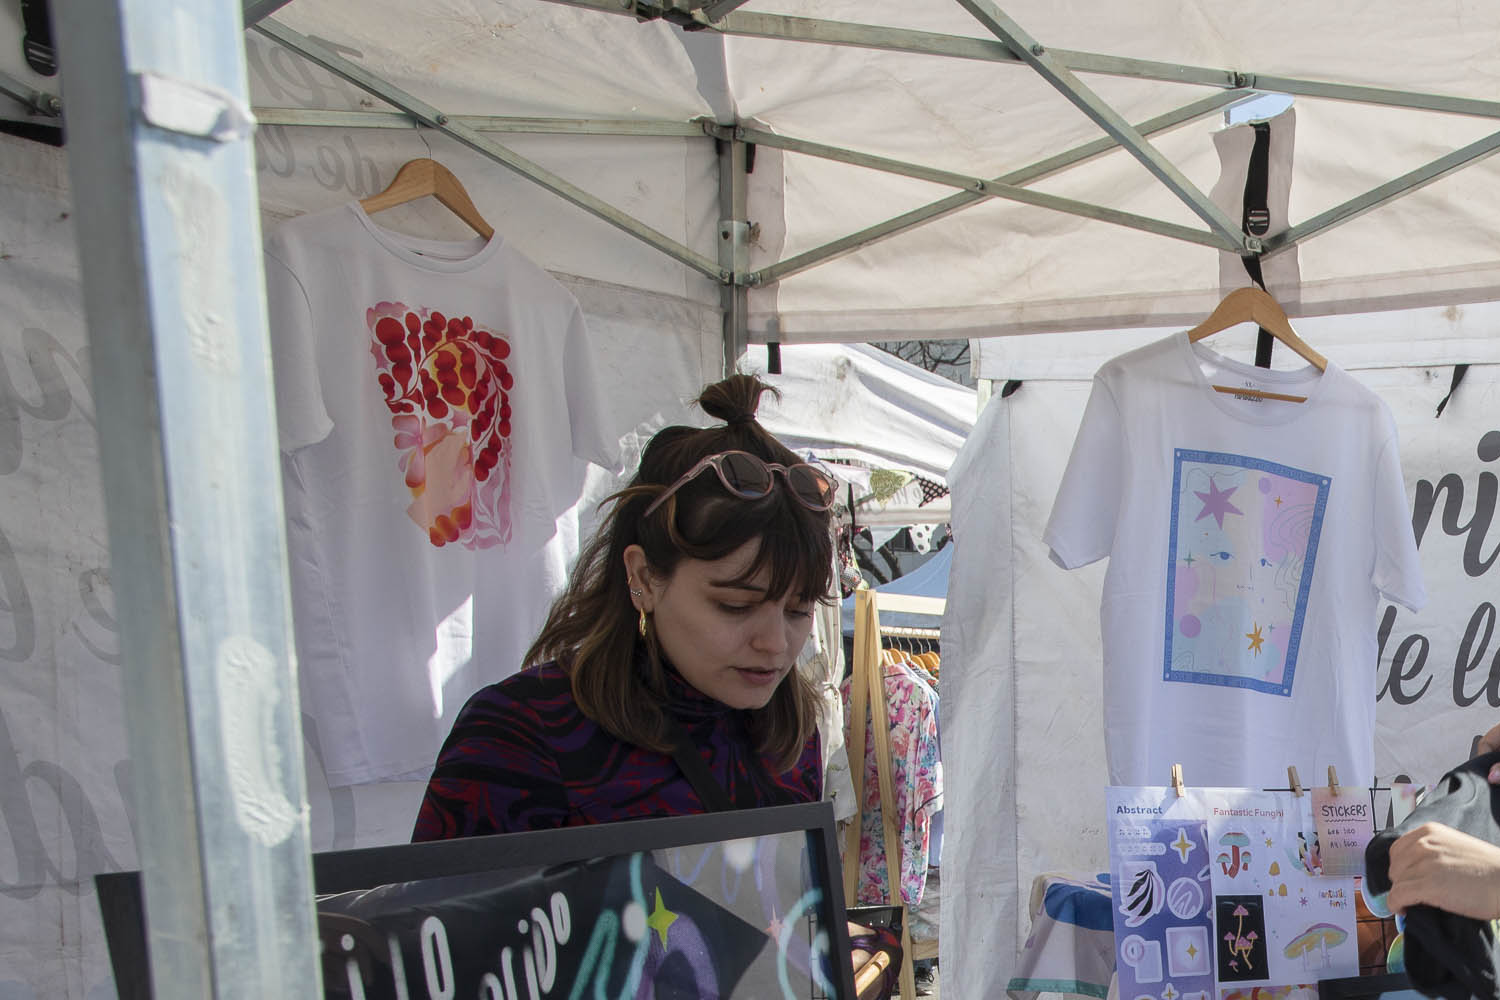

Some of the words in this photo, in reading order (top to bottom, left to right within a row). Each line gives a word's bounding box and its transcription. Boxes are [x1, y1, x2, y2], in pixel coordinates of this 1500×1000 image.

[1115, 804, 1163, 816] Abstract
[1213, 807, 1254, 817] Fantastic
[1321, 804, 1367, 817] STICKERS
